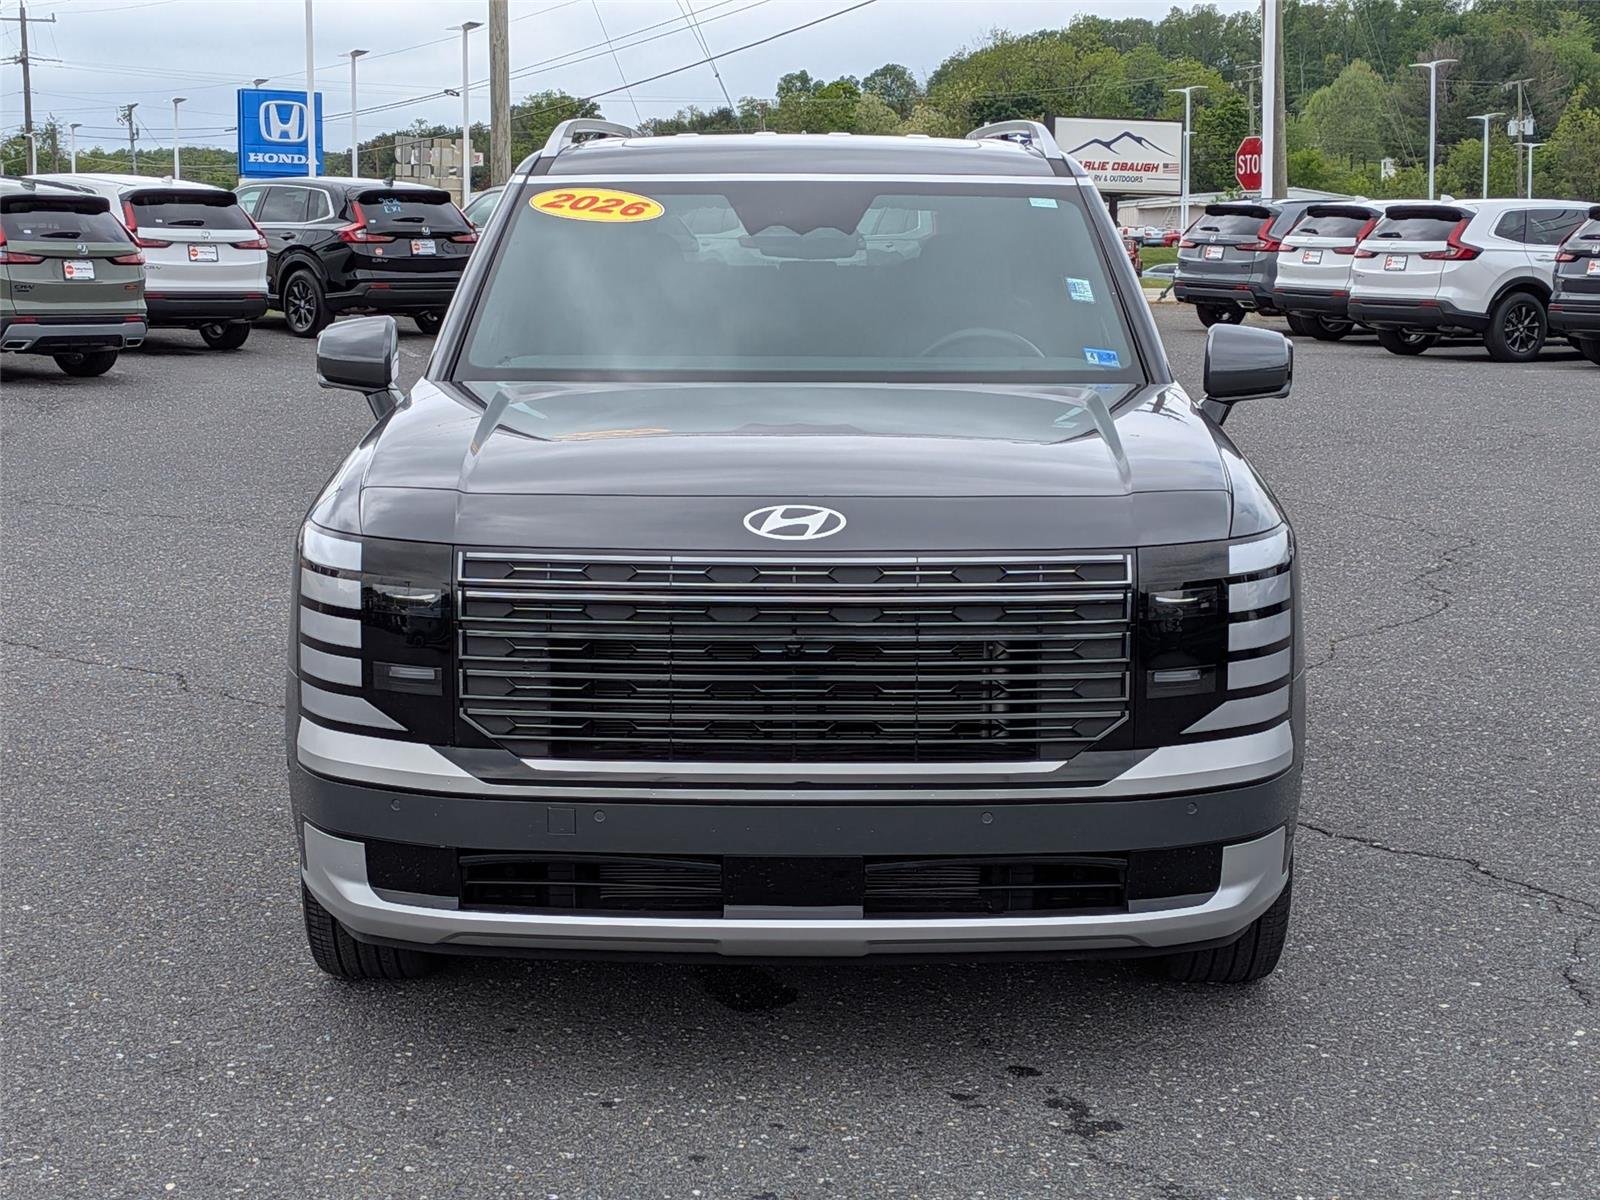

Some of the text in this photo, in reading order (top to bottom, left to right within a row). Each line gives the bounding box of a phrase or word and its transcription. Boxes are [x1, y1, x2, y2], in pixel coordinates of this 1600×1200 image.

[1079, 160, 1160, 173] RLIE OBAUGH
[1238, 154, 1263, 174] STO
[1094, 174, 1104, 182] RV
[1109, 175, 1144, 184] OUTDOORS
[540, 193, 651, 217] 2026
